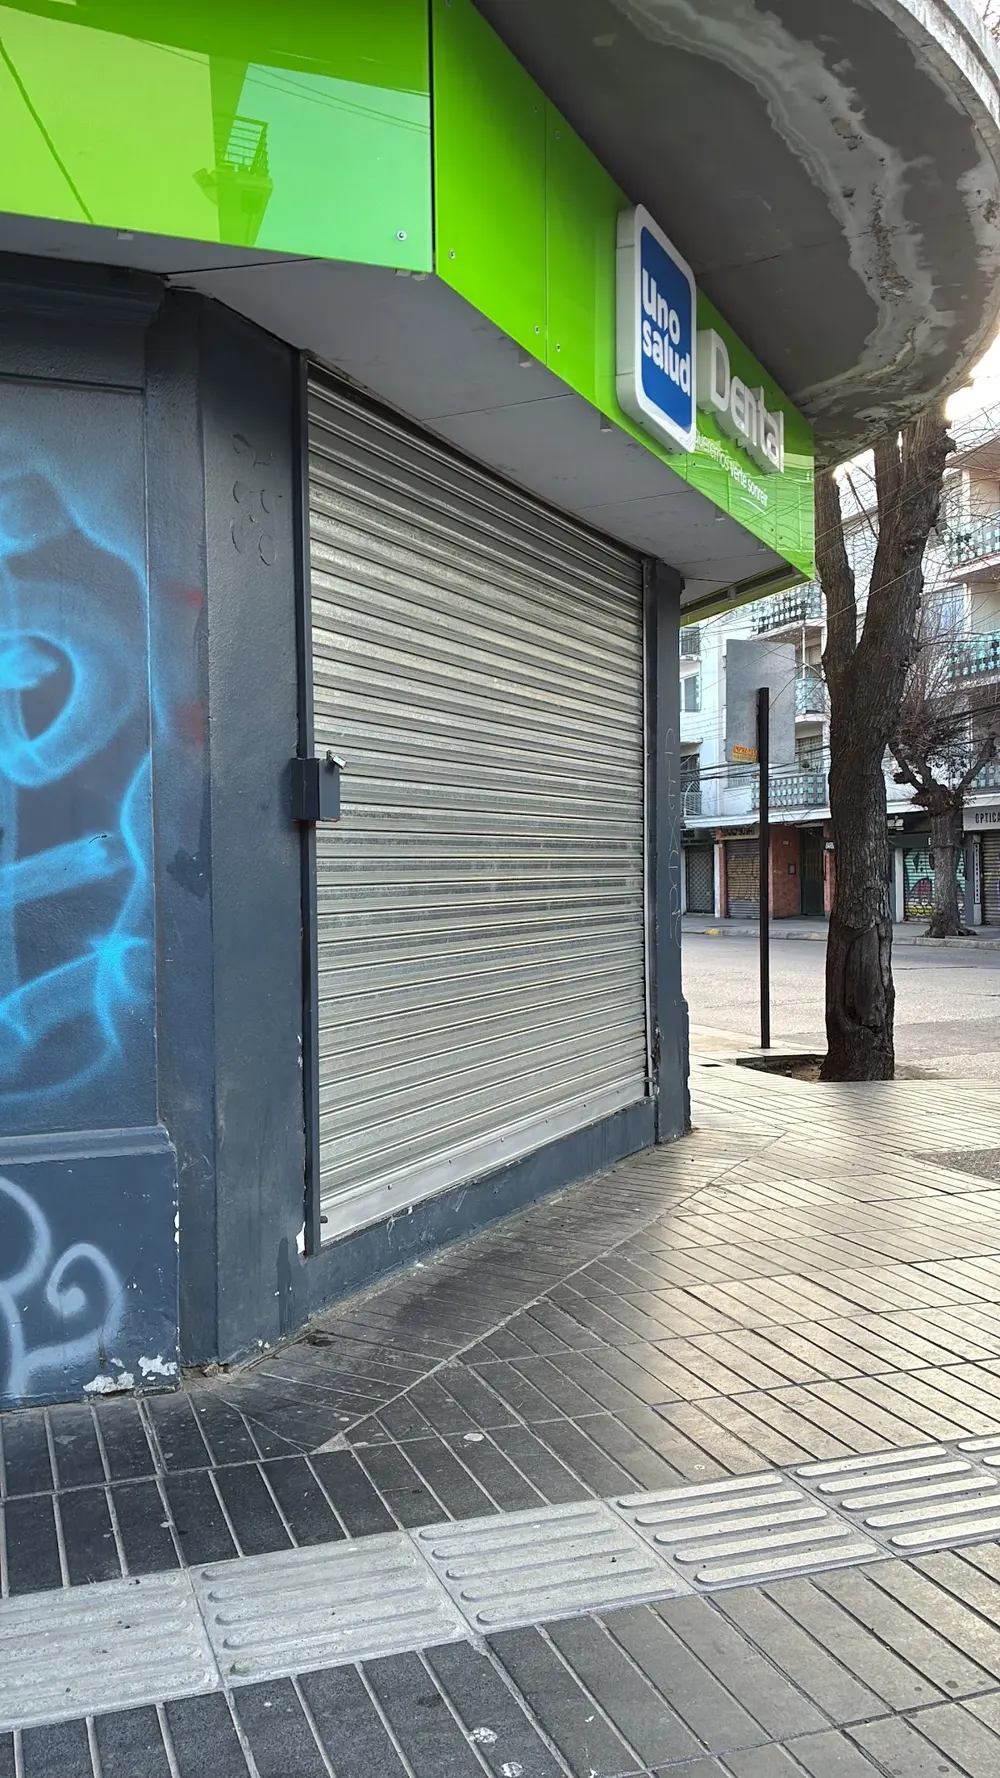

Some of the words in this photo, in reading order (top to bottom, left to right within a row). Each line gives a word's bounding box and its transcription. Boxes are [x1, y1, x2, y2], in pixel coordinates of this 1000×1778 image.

[642, 319, 691, 397] salud
[708, 327, 785, 474] Dental
[696, 430, 730, 472] ueremos
